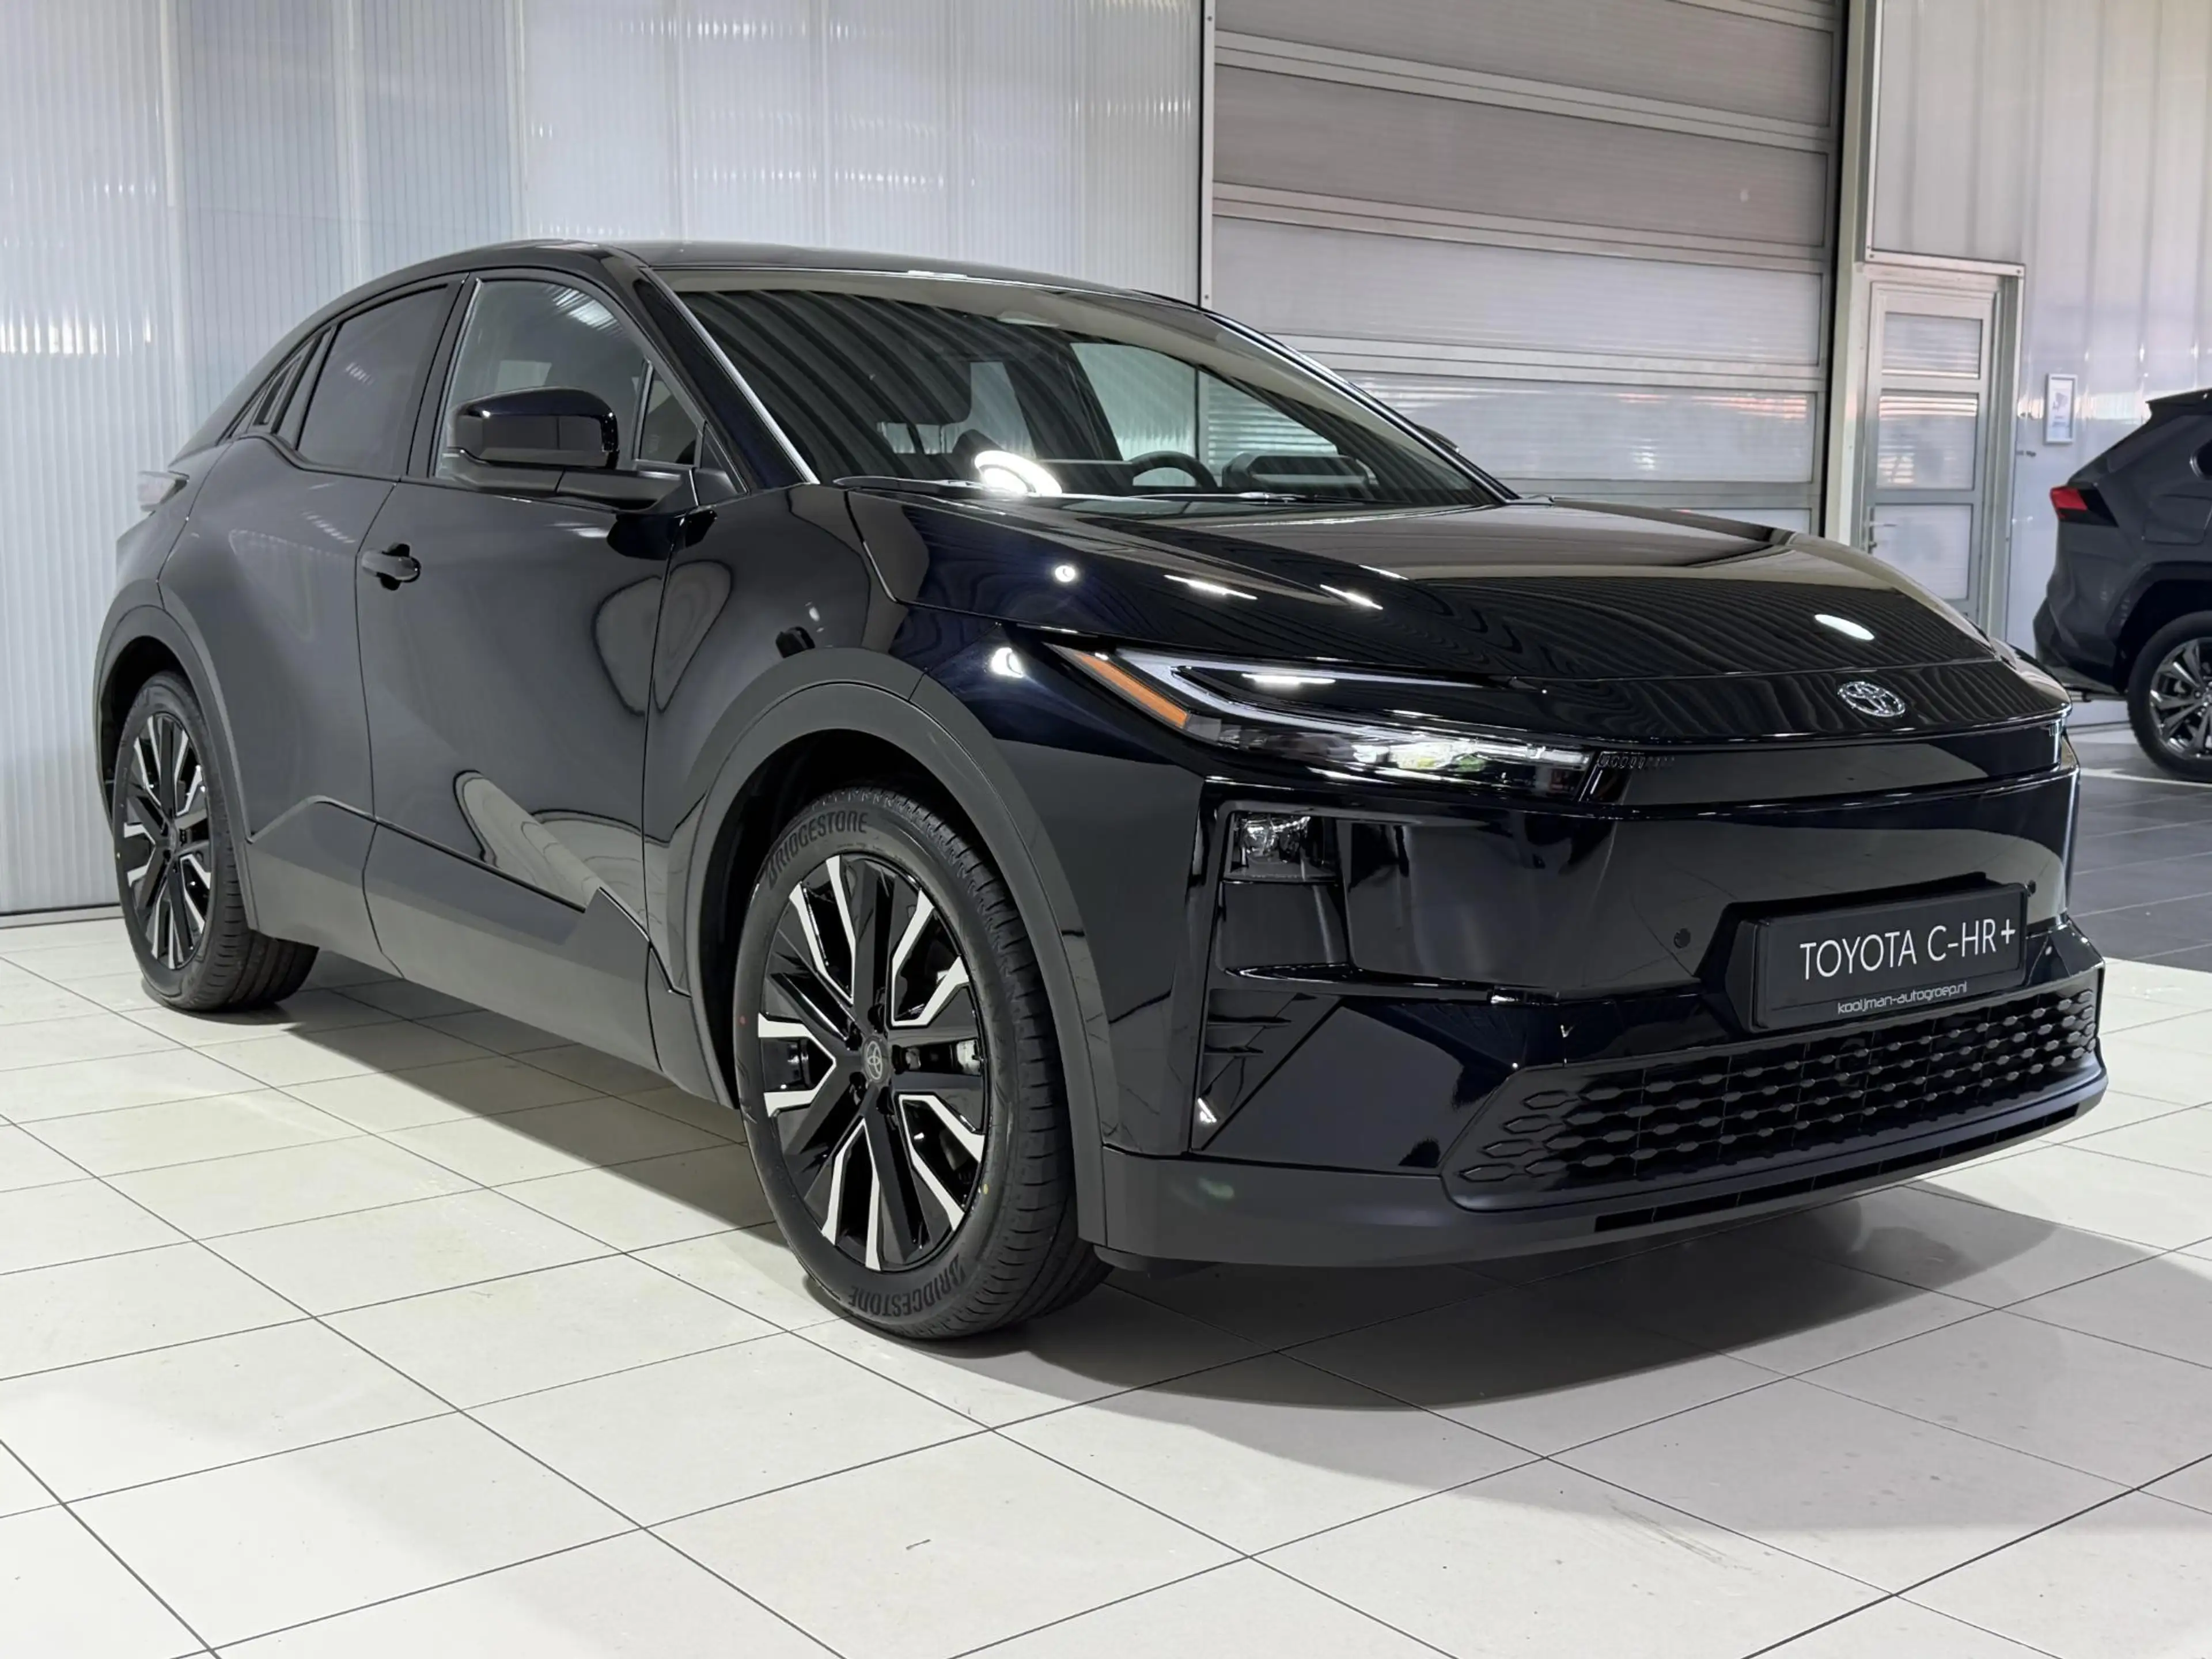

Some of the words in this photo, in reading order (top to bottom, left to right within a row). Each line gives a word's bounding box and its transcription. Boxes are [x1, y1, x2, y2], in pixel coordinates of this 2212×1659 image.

[767, 810, 868, 889] BRIDGESTONE
[1800, 930, 1917, 980] TOYOTA
[1927, 918, 2016, 961] C-HR+
[849, 1253, 966, 1317] BRIDGESTONE
